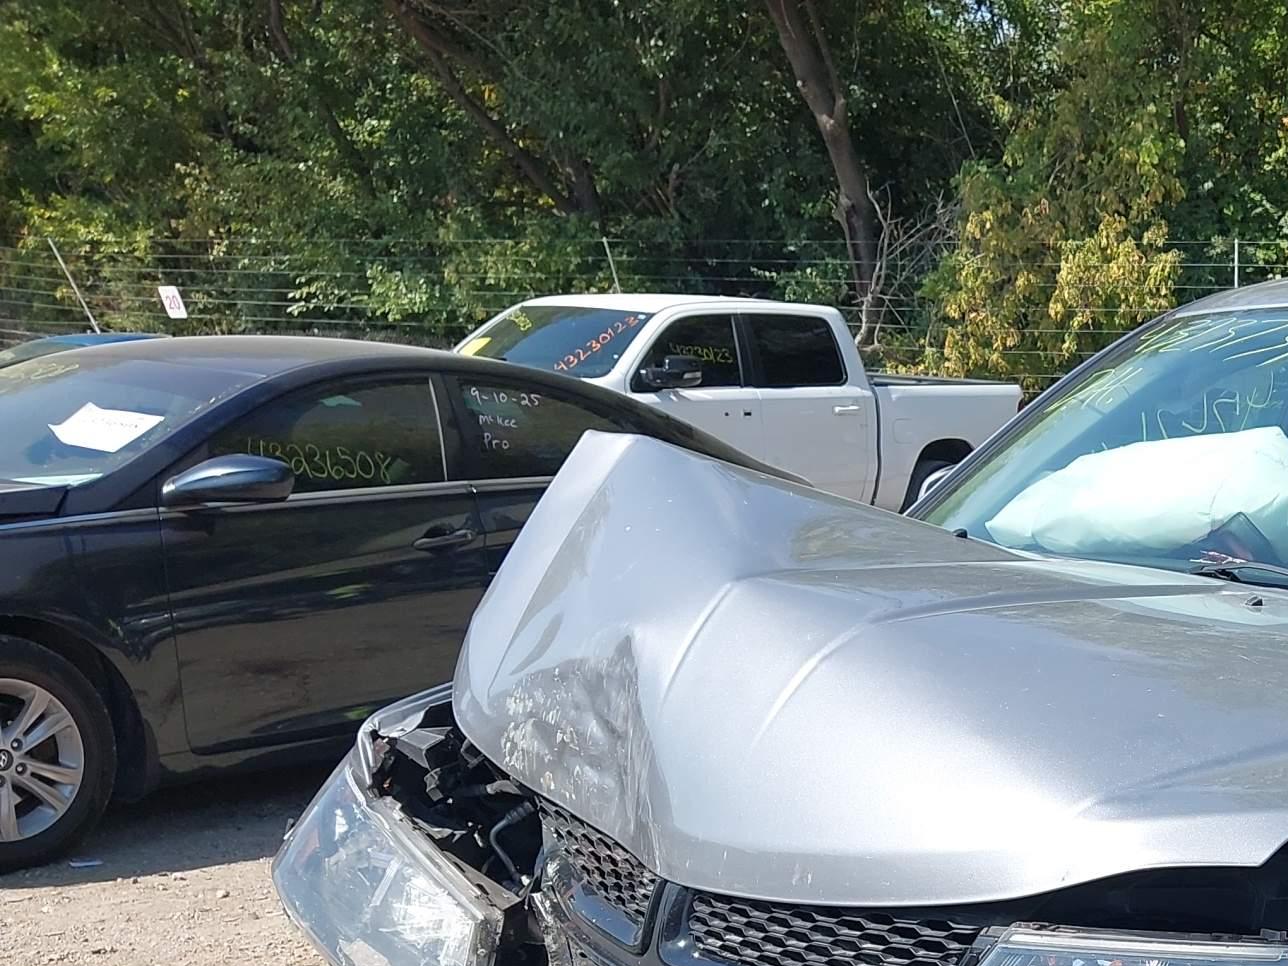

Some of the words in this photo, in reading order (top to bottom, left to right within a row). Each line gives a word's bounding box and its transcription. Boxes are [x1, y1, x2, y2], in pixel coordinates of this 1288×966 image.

[165, 295, 181, 311] 20
[470, 387, 542, 408] 9-10-25
[483, 432, 510, 449] Pro
